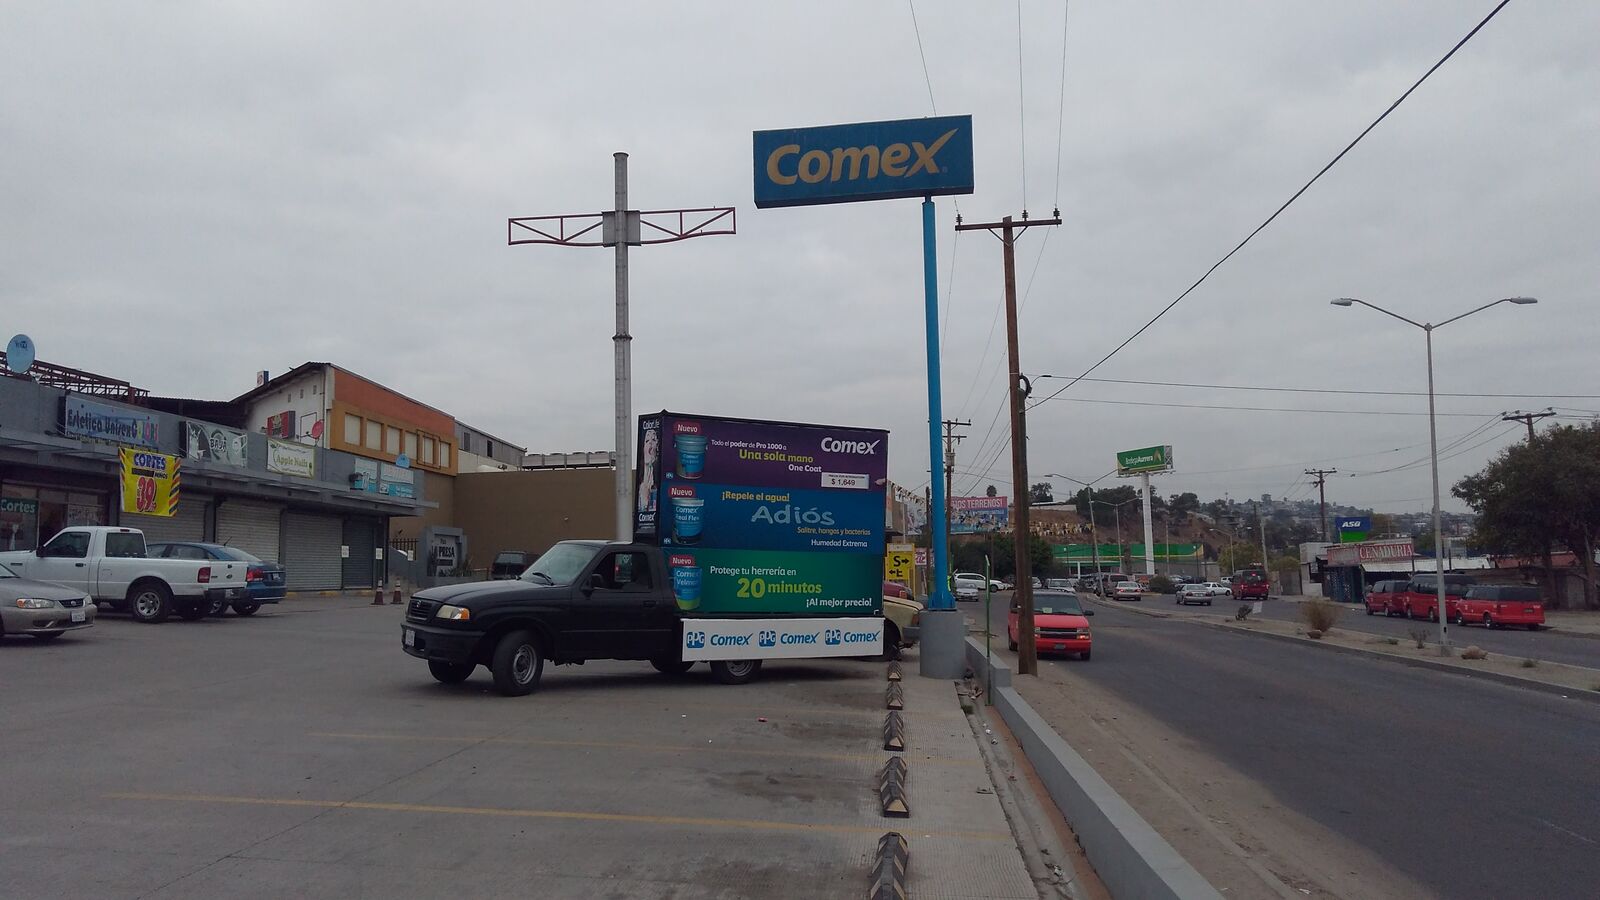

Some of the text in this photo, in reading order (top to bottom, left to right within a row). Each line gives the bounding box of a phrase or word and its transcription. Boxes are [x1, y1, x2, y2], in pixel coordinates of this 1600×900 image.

[767, 127, 959, 185] Comex
[677, 424, 698, 432] Nuevo
[821, 437, 880, 455] Comex
[277, 454, 294, 465] Apple
[739, 449, 761, 460] Una
[763, 452, 785, 461] sola
[134, 453, 166, 470] CORTES
[671, 488, 692, 496] Nuevo
[722, 491, 754, 501] ¡Repele
[765, 493, 790, 503] agua!
[0, 499, 35, 513] Cortes
[967, 499, 1003, 508] TERRENOS!
[751, 504, 835, 526] Adiós
[439, 546, 455, 558] PRESA
[1360, 544, 1412, 559] CENADURIA
[894, 555, 901, 567] S
[710, 566, 740, 576] Protege
[752, 566, 786, 576] herrería
[736, 578, 822, 598] 20 minutos
[806, 598, 872, 608] ¡Al mejor precio!
[687, 630, 880, 647] PPG Comex PPG Comex PPG Comex
